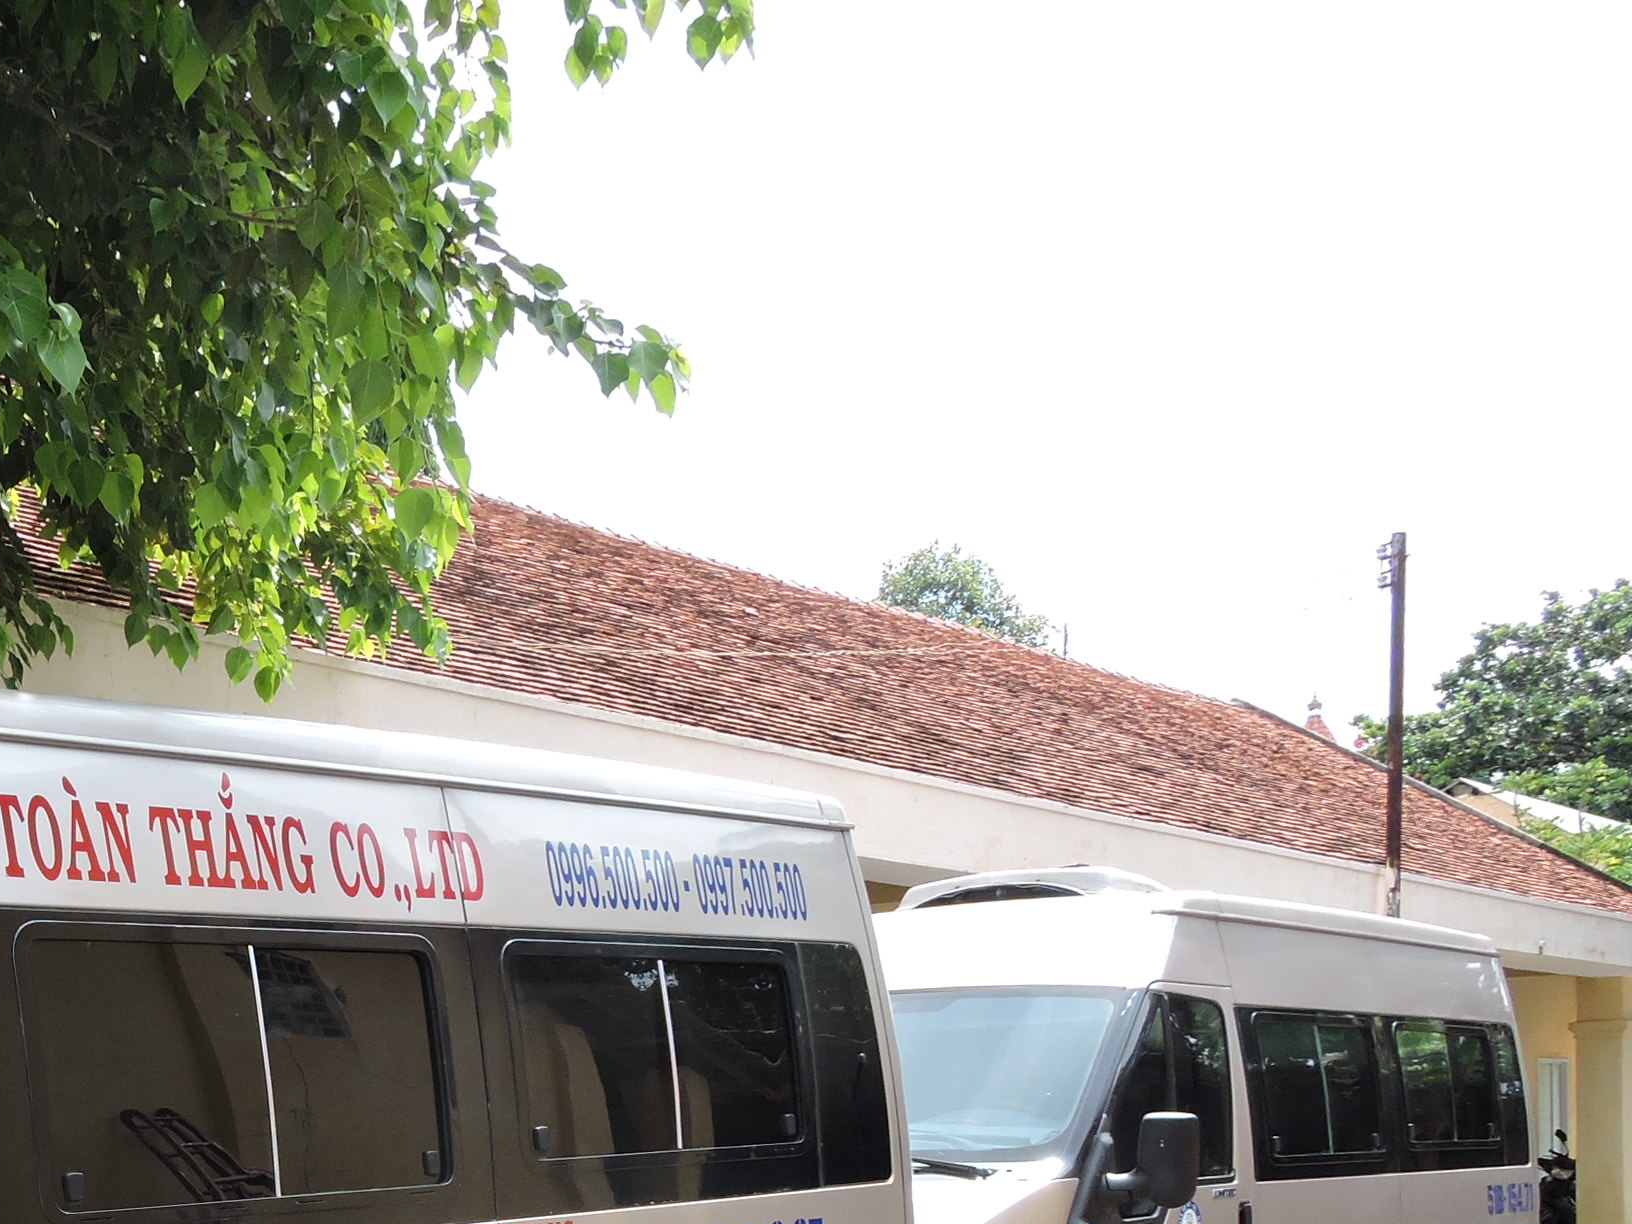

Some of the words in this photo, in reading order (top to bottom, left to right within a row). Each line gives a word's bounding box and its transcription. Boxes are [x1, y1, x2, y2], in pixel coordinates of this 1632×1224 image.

[148, 771, 316, 894] THẮNG
[329, 821, 485, 913] CO.,LTD
[545, 840, 680, 913] 0996.500.500
[693, 853, 808, 921] 0997.500.500
